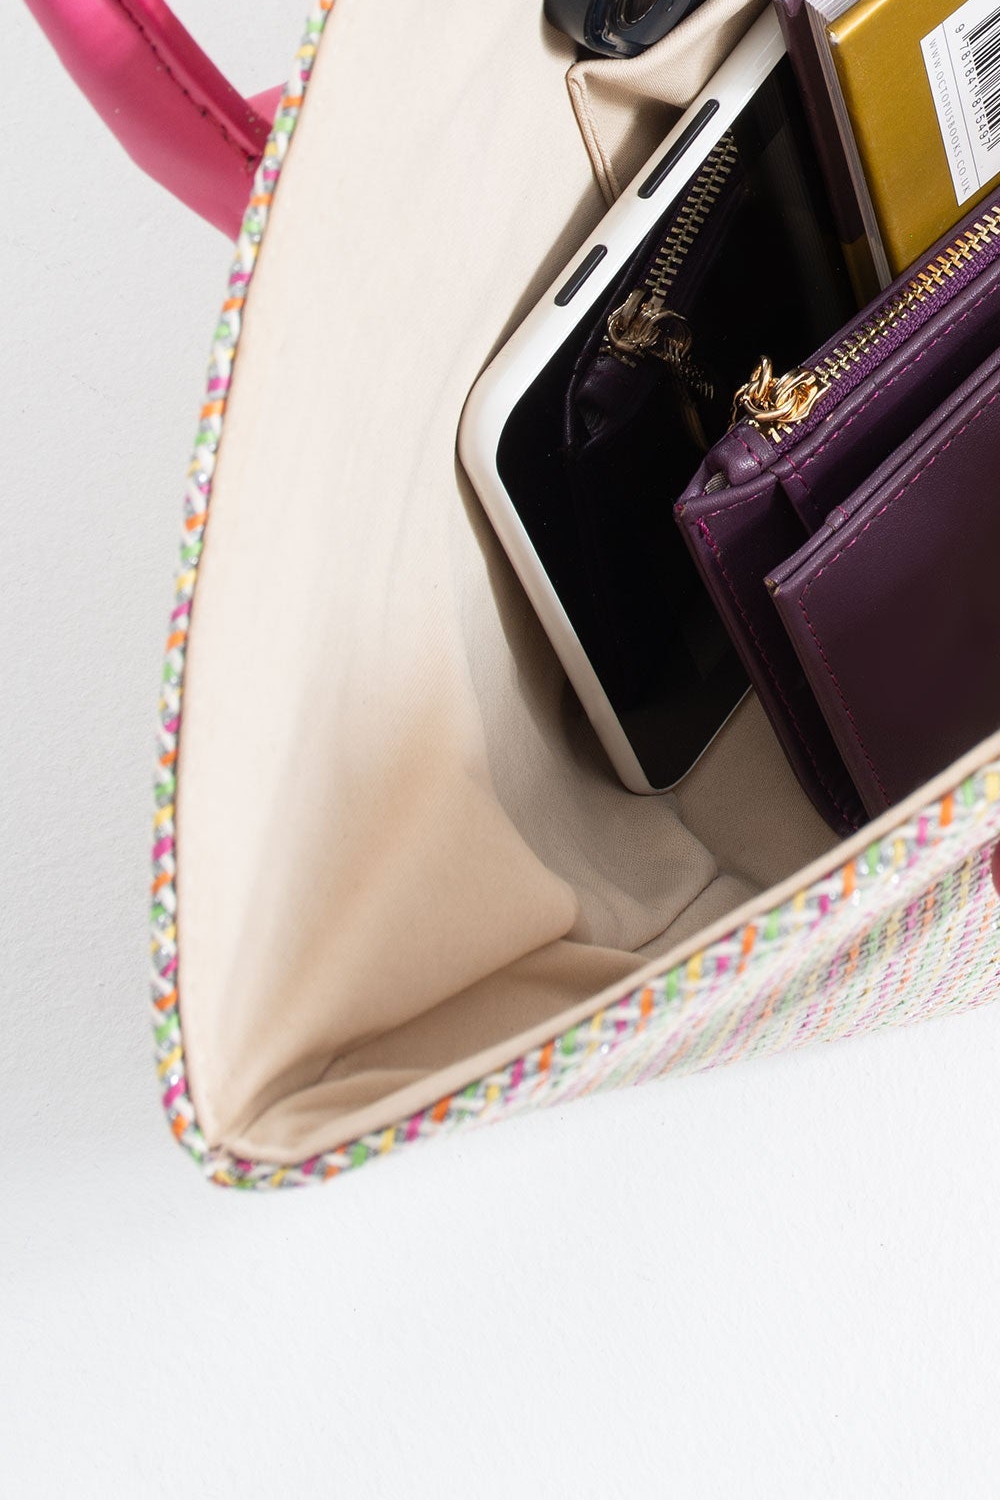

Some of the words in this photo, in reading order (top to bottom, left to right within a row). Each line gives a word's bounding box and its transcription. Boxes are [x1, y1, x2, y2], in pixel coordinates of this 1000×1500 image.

[954, 22, 966, 34] 9
[959, 41, 978, 93] 781841
[929, 39, 971, 195] WWW.OCTOPUSBOOKS.CO.UK
[971, 97, 991, 146] 815497
